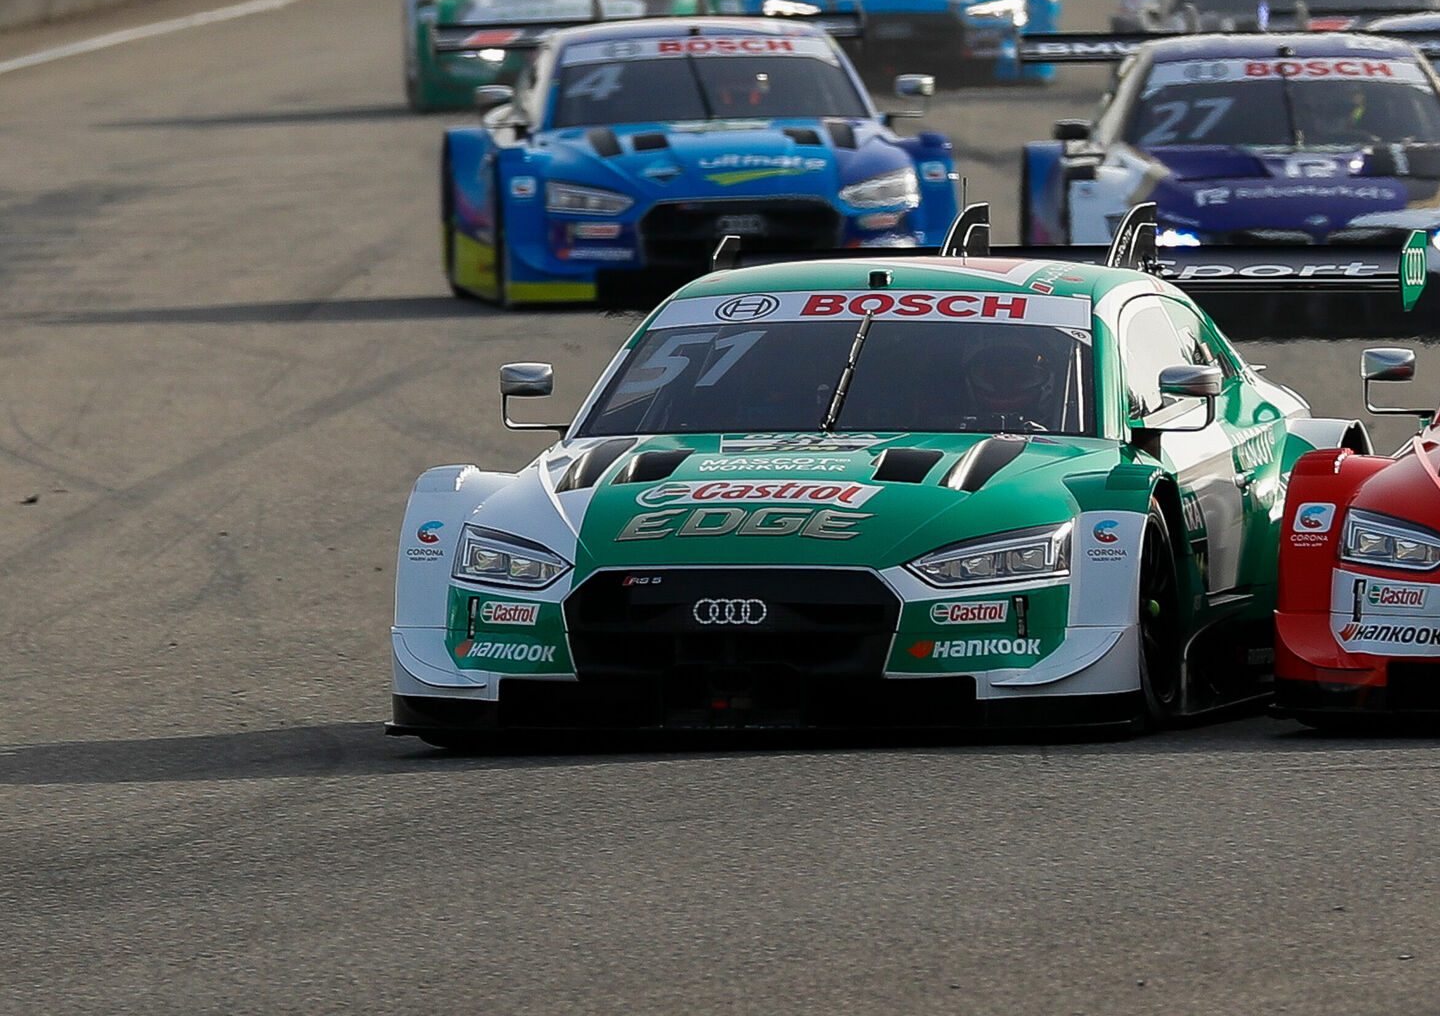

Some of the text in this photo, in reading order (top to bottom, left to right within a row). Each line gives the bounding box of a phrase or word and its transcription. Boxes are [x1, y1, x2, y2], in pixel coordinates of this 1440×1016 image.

[656, 37, 795, 57] BOSCH
[1243, 61, 1394, 79] BOSCH
[564, 59, 626, 102] 4
[1140, 96, 1236, 144] 27
[800, 292, 1028, 320] BOSCH
[603, 329, 768, 395] 51
[699, 464, 847, 472] WORKWEAR
[701, 457, 835, 466] MASCOT
[691, 482, 863, 504] Castrol
[613, 507, 879, 542] EDGE
[1289, 534, 1329, 542] CORONA
[406, 548, 444, 557] CORONA
[1086, 548, 1128, 557] CORONA
[1379, 587, 1425, 606] Castrol
[492, 603, 537, 623] Castrol
[949, 602, 1005, 622] Castrol
